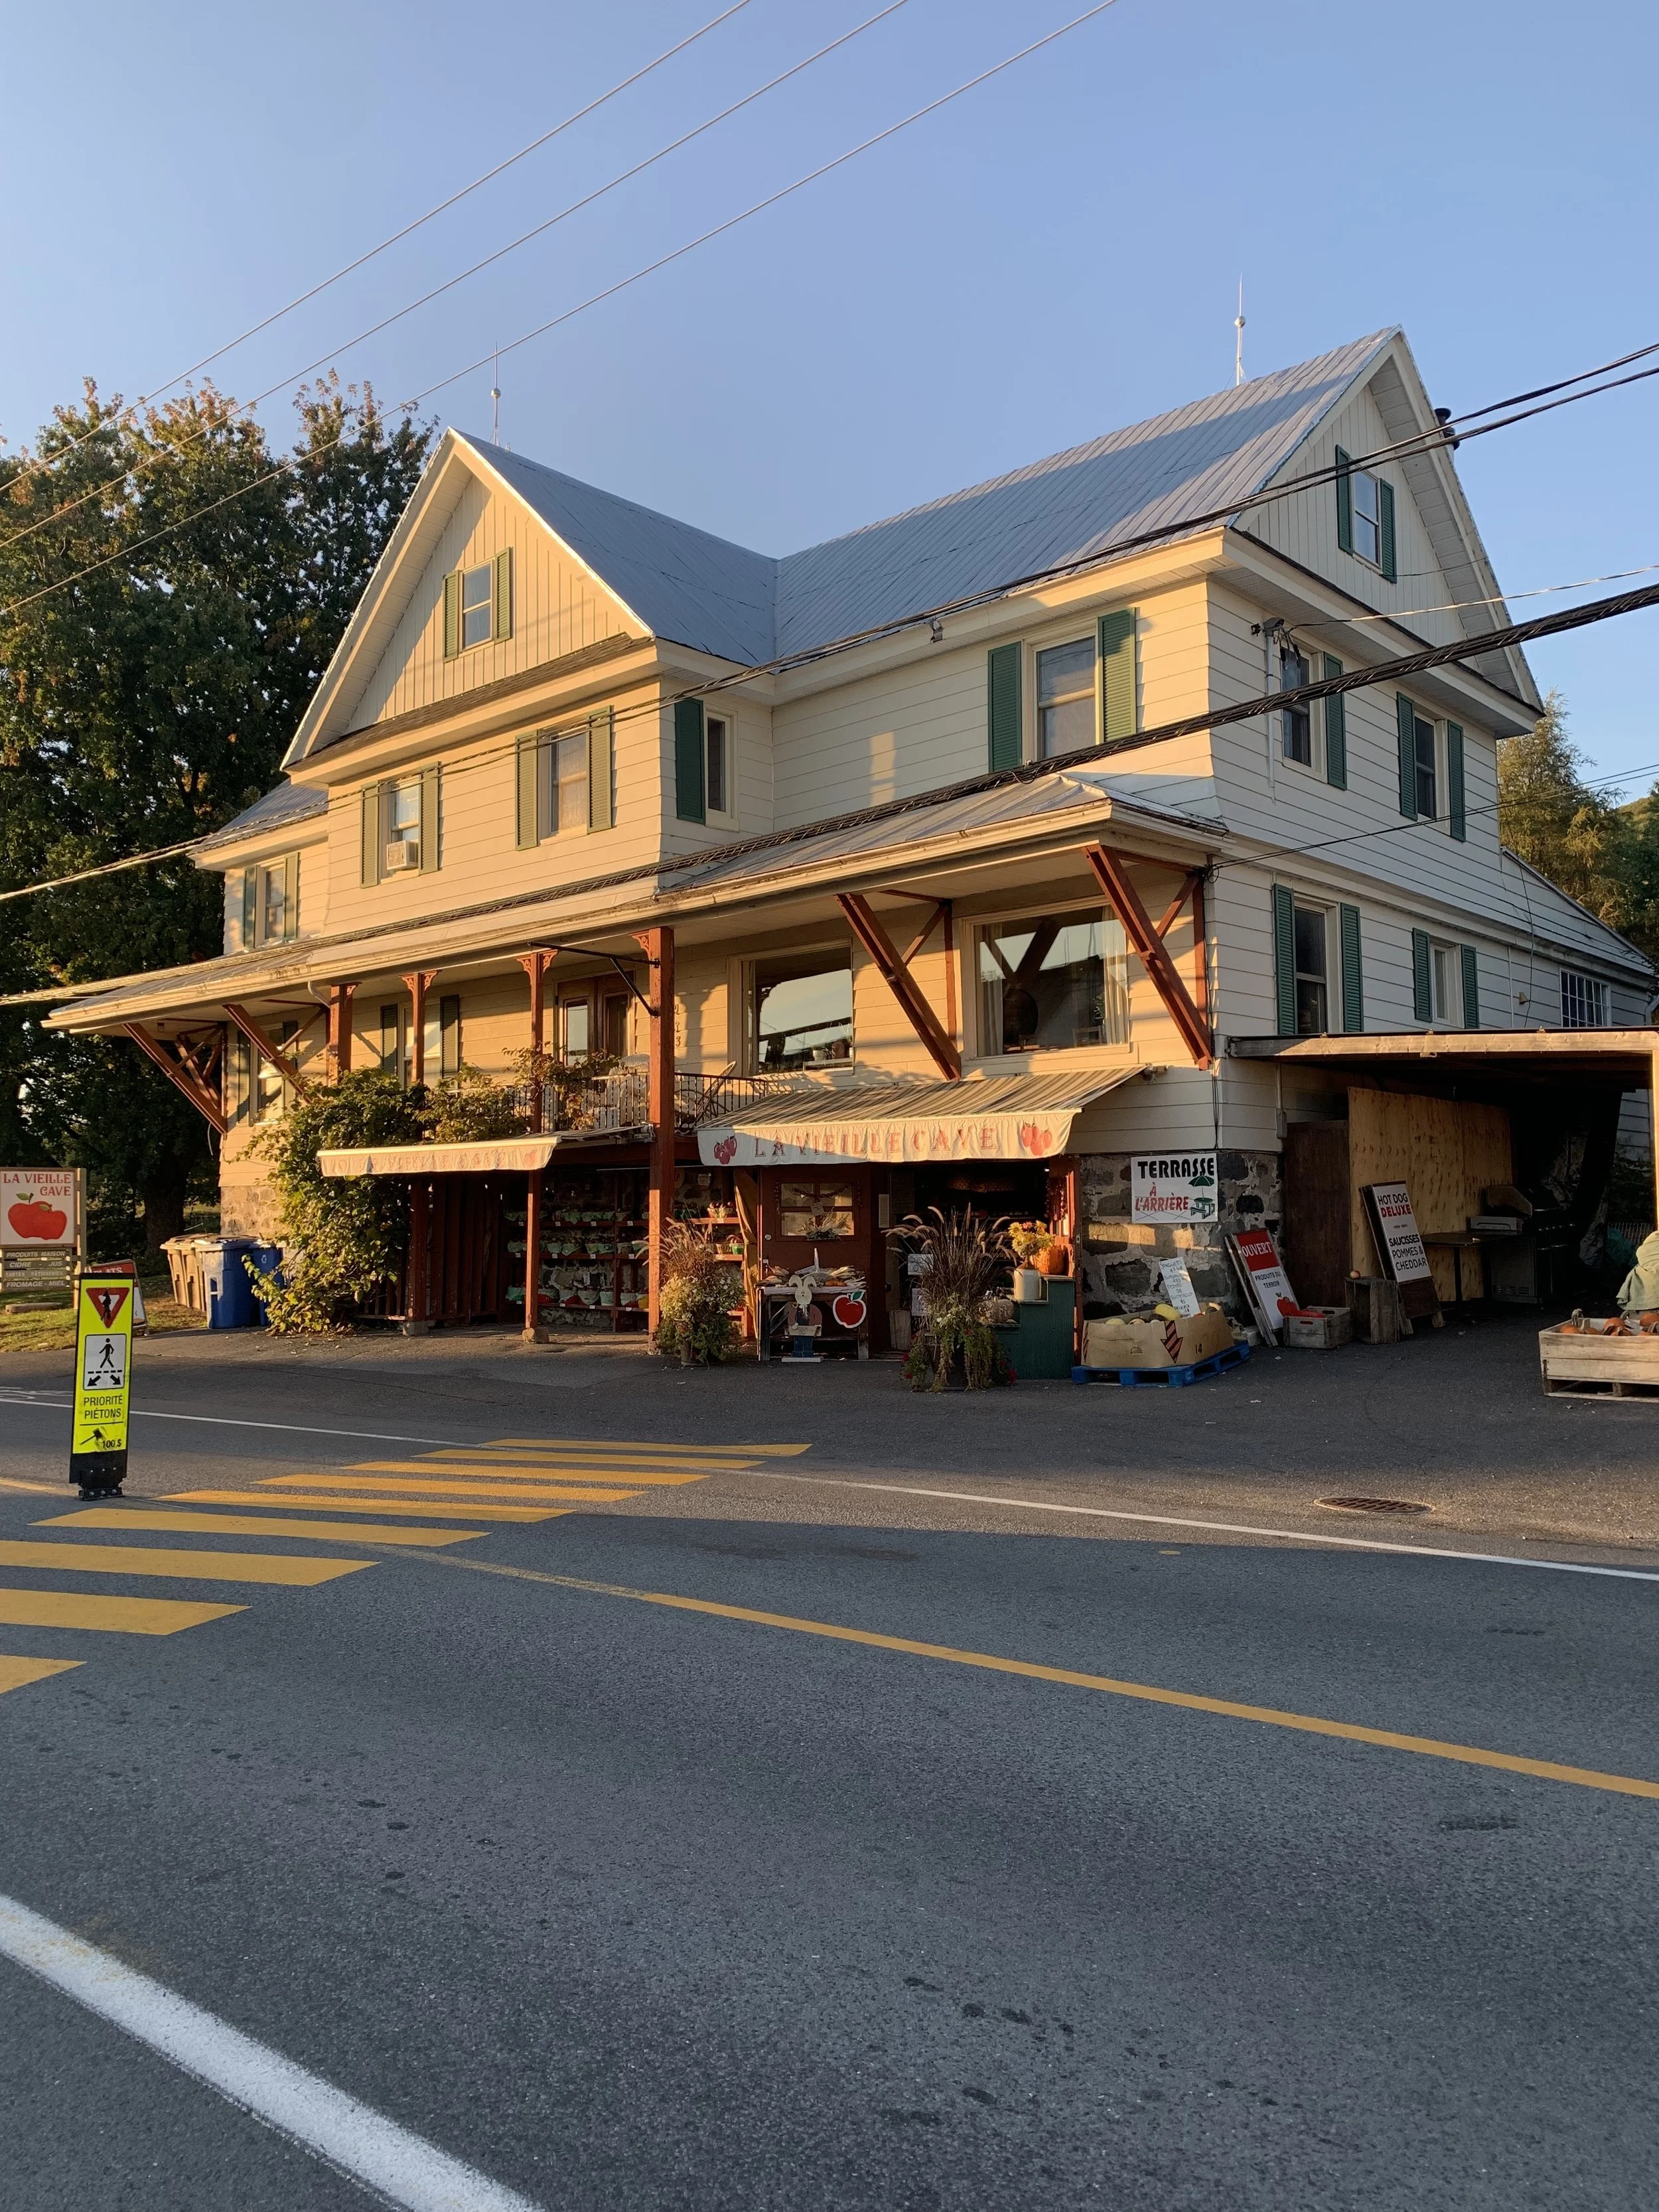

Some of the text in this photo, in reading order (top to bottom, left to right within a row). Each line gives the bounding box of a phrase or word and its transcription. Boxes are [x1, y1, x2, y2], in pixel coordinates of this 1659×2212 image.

[755, 1125, 997, 1157] LA VIEILLE CAVE
[1137, 1157, 1214, 1179] TERRASSE
[3, 1173, 71, 1183] LA VIEILLE
[40, 1186, 71, 1196] CAVE
[1149, 1181, 1157, 1197] À
[1135, 1192, 1189, 1212] L'ARRIÈRE
[1378, 1193, 1408, 1205] HOT DOG
[1380, 1205, 1411, 1218] DELUXE
[1389, 1234, 1420, 1247] SAUCISSES
[1242, 1242, 1272, 1257] OUVERT
[1392, 1246, 1423, 1259] POMMES &
[1396, 1258, 1427, 1271] CHEDDAR
[1254, 1272, 1275, 1282] PRODUITS
[1263, 1280, 1281, 1289] TERROIR
[1195, 1343, 1202, 1355] 14
[84, 1393, 123, 1406] PRIORITÉ
[84, 1408, 121, 1419] PIÉTONS
[102, 1439, 115, 1448] 100
